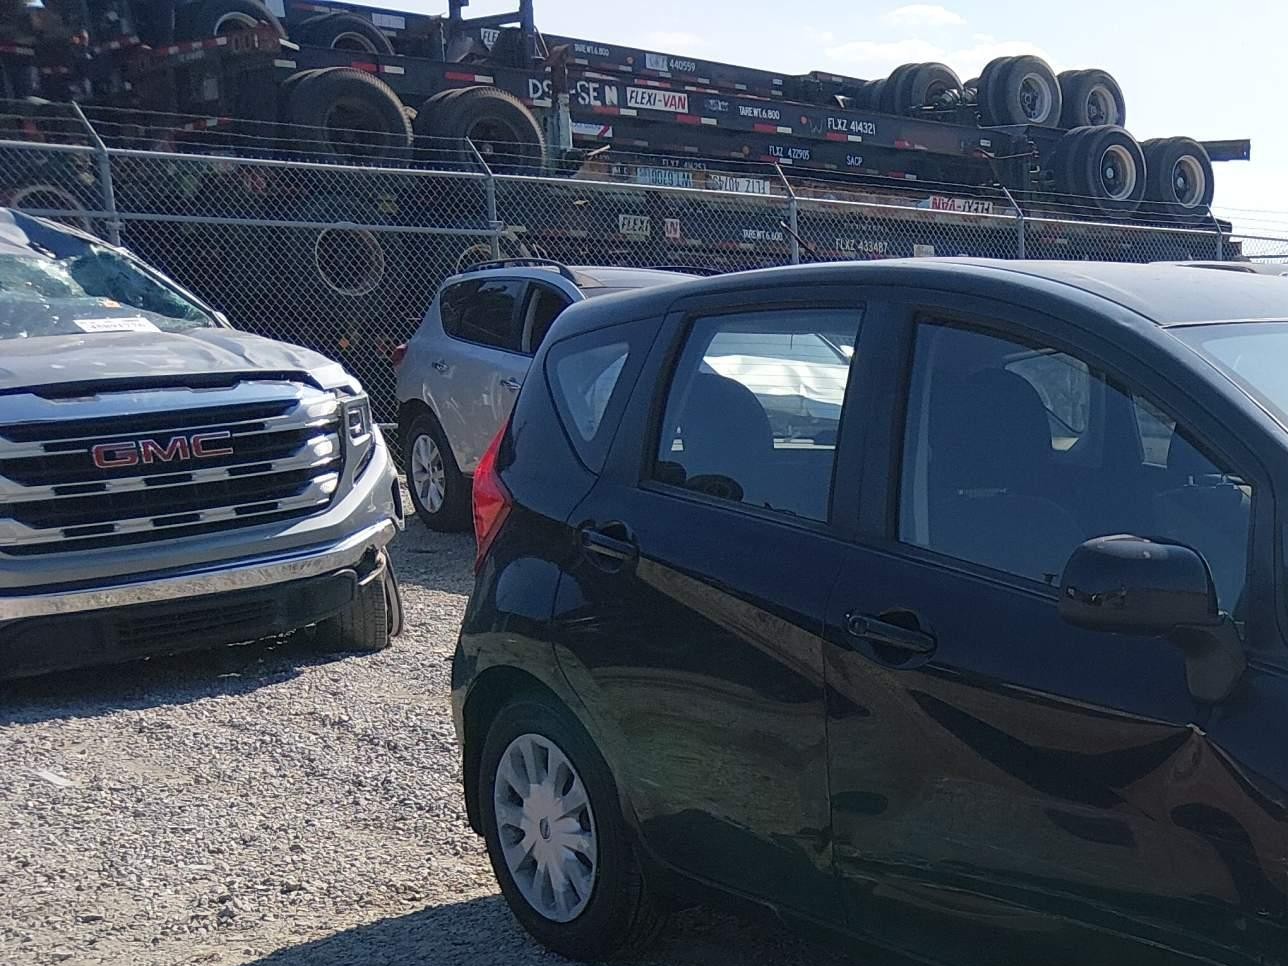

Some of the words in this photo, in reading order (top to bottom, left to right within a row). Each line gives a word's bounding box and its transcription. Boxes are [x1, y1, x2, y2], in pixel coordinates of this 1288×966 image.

[628, 89, 688, 111] FLEXI-VAN
[827, 117, 848, 132] FLXZ
[849, 120, 876, 136] 414321
[91, 430, 234, 469] GMC
